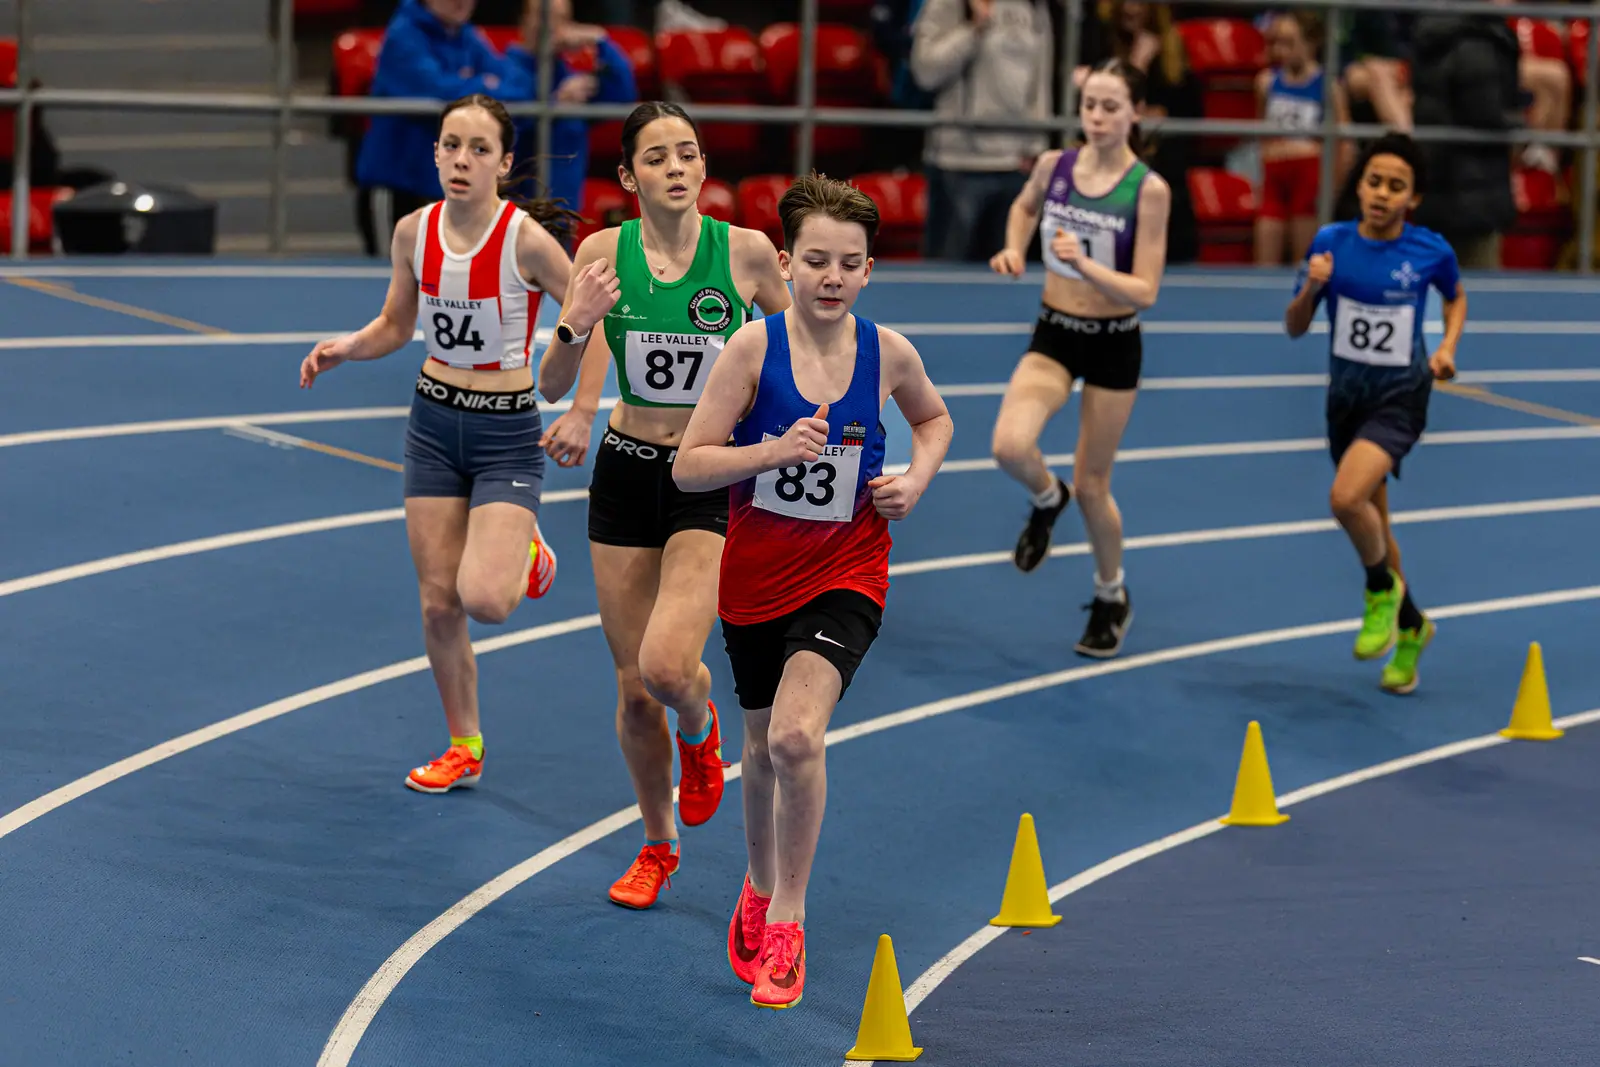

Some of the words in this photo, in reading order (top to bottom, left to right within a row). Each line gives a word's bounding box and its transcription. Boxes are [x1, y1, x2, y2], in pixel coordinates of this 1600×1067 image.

[426, 296, 442, 307] LEE
[444, 300, 482, 310] VALLEY
[690, 296, 700, 309] City
[432, 312, 485, 352] 84
[694, 319, 718, 331] Athletic
[718, 317, 730, 329] Club
[641, 333, 662, 344] LEE
[665, 335, 709, 346] VALLEY
[1349, 318, 1394, 353] 82
[645, 349, 704, 391] 87
[453, 392, 513, 411] NIKE
[604, 432, 658, 460] PRO
[818, 446, 847, 457] LEY
[775, 462, 837, 507] 83
